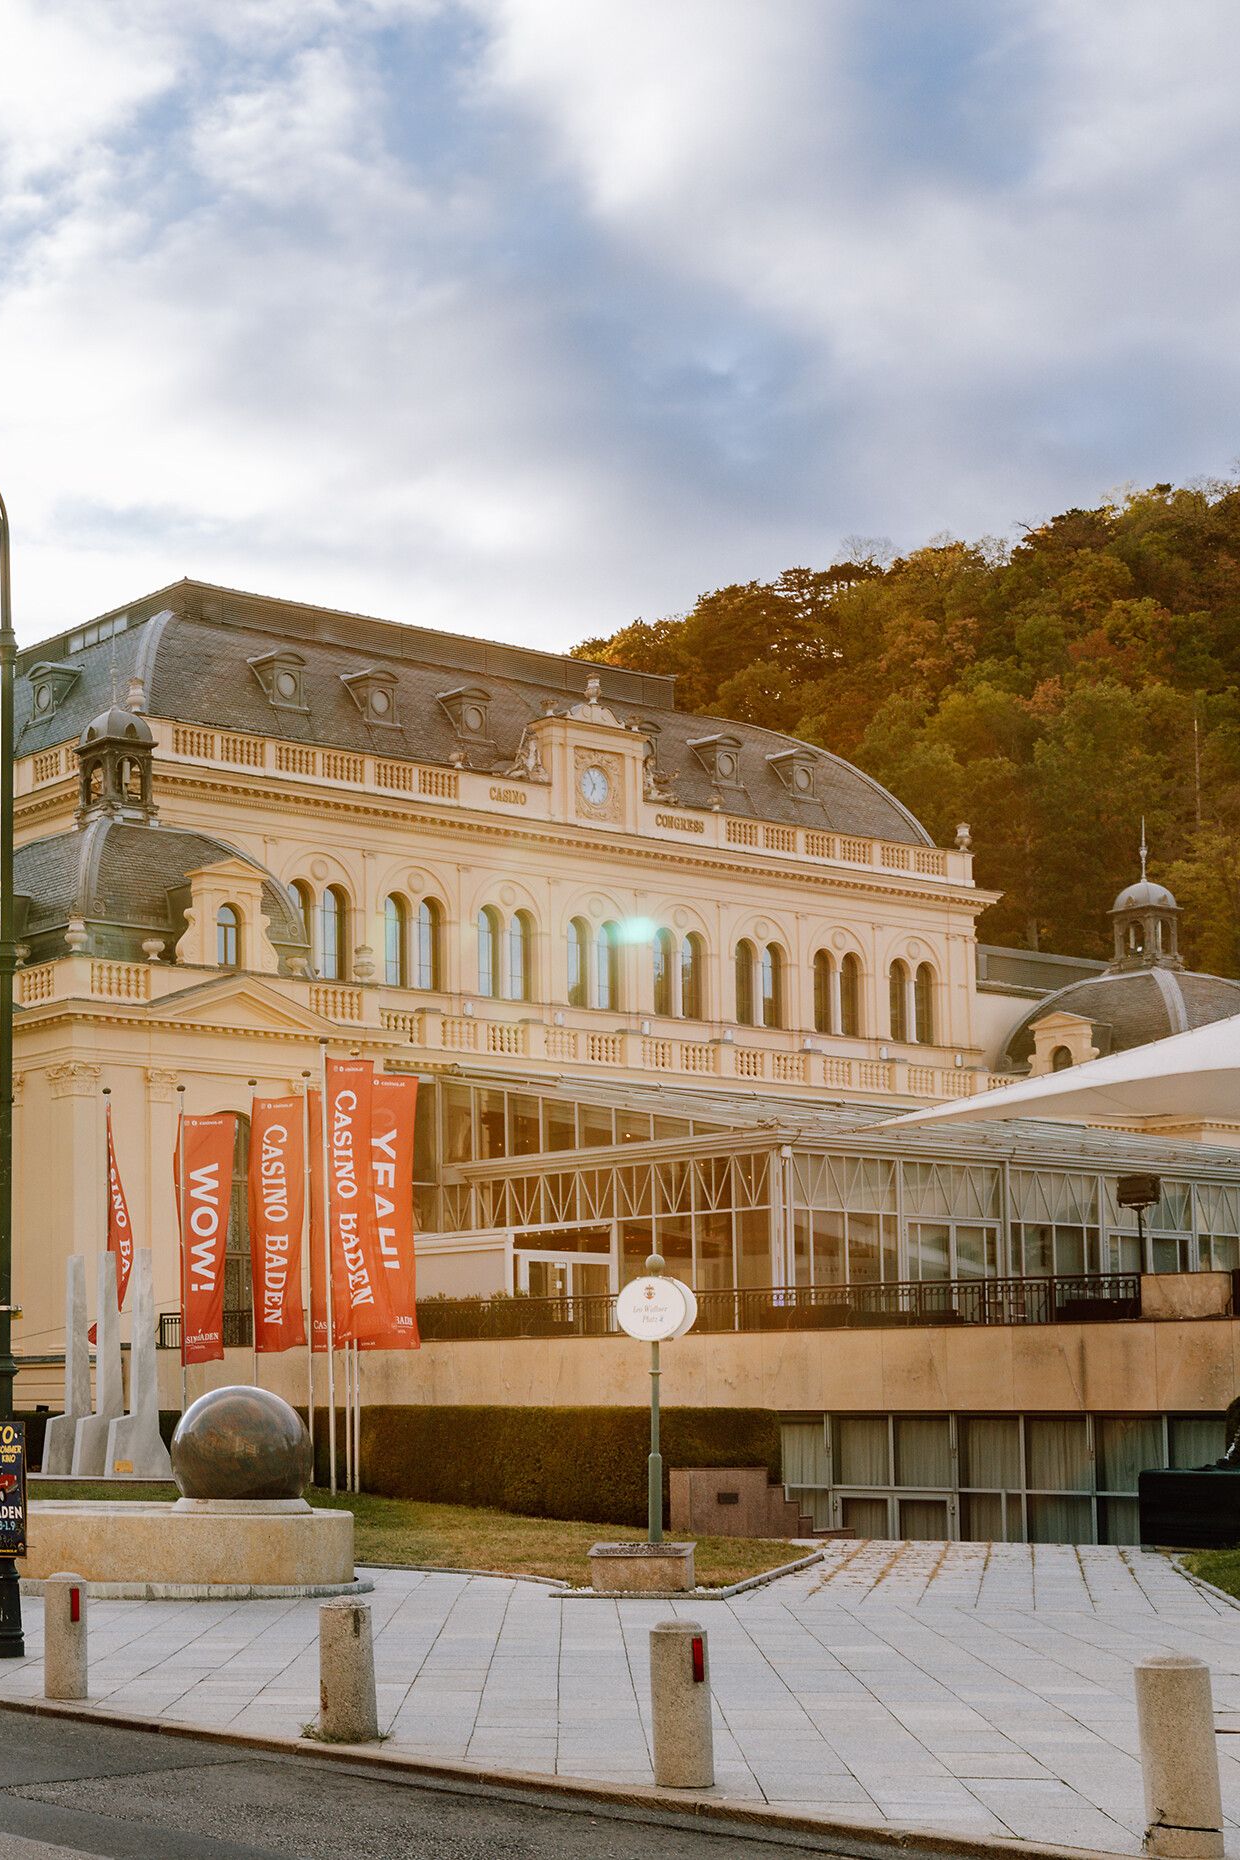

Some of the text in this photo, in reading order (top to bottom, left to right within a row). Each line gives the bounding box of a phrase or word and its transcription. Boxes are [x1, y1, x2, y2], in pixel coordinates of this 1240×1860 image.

[489, 785, 528, 806] CASINO
[655, 813, 705, 834] CONGRESS
[333, 1089, 359, 1200] CASINO
[189, 1162, 220, 1292] WOW!
[261, 1124, 289, 1326] CASINO BADEN
[339, 1212, 375, 1310] BADEN
[1, 1454, 16, 1464] KINO
